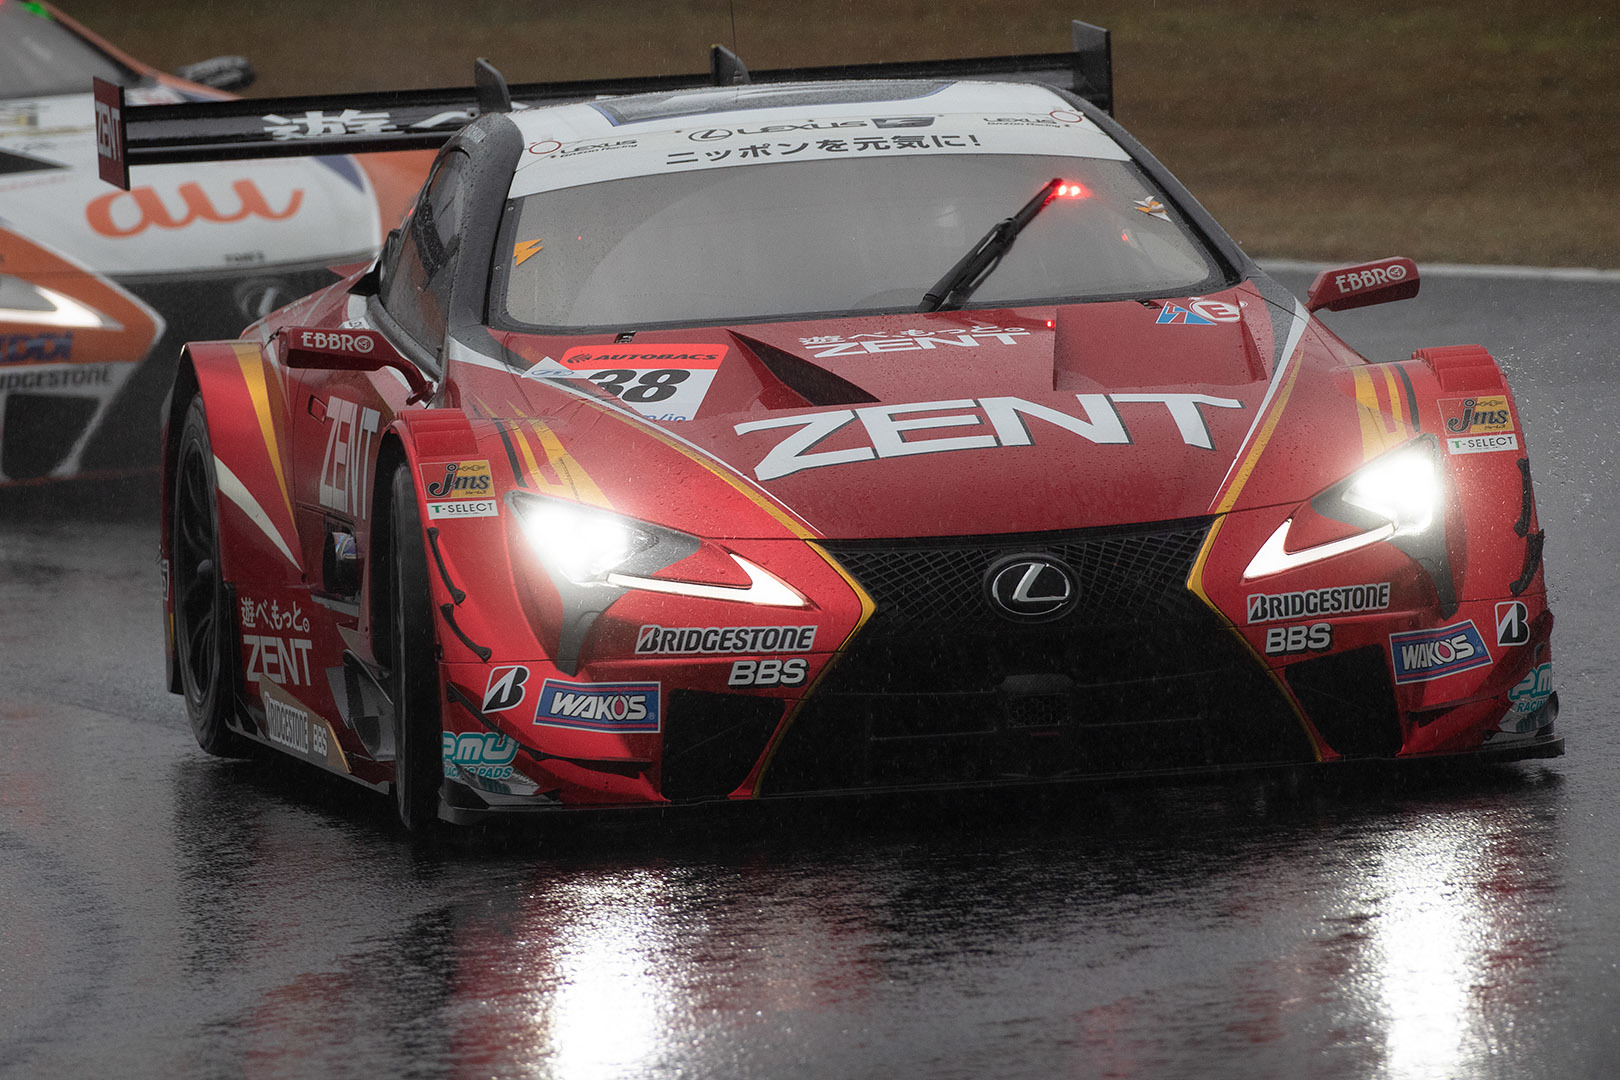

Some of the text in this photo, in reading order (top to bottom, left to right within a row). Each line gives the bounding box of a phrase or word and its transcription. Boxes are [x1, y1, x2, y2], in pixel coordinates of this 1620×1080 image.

[737, 120, 868, 135] LEXUS
[86, 178, 304, 238] au
[1335, 265, 1407, 294] EBBRO
[301, 332, 374, 353] EBBRO
[594, 353, 720, 361] AUTOBACS
[805, 332, 1031, 358] ZENT
[1446, 398, 1510, 434] jms
[733, 393, 1246, 482] ZENT
[1451, 436, 1514, 449] T-SELECT
[319, 395, 381, 521] ZENT
[427, 462, 490, 498] jms
[431, 503, 493, 514] T-SELECT
[1247, 582, 1390, 624] BRIDGESTONE
[635, 625, 818, 655] BRIDGESTONE
[1265, 622, 1334, 657] BBS
[243, 634, 313, 687] ZENT
[728, 658, 810, 690] BBS
[478, 766, 514, 779] PADS
